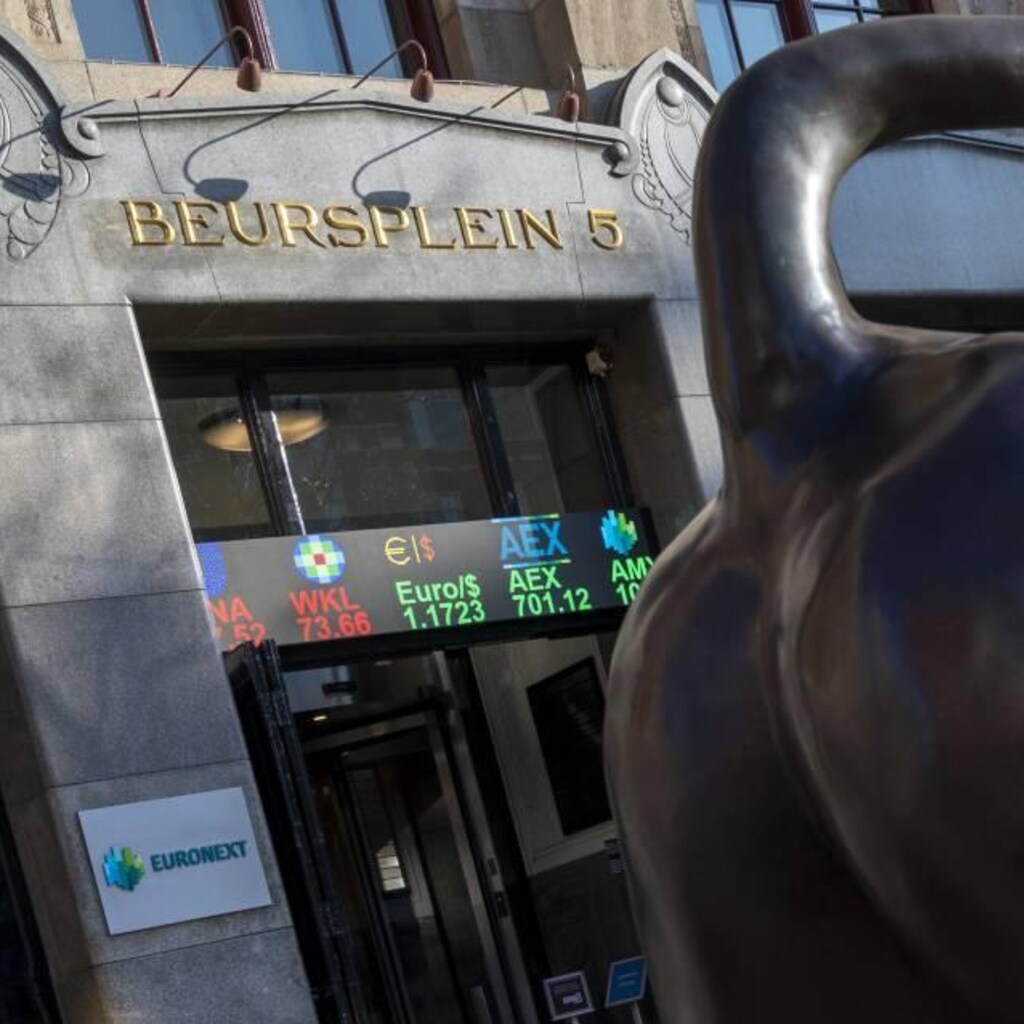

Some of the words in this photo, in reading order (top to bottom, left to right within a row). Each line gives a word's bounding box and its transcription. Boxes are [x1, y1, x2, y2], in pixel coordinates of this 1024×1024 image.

[120, 200, 563, 250] BEURSPLEIN
[587, 208, 623, 250] 5
[501, 521, 568, 560] AEX
[396, 574, 480, 604] Euro/$
[509, 566, 561, 593] AEX
[289, 586, 360, 615] WKL
[404, 600, 485, 629] 1.1723
[512, 588, 592, 617] 701.12
[297, 611, 372, 641] 73.66
[150, 840, 247, 872] EURONEXT
